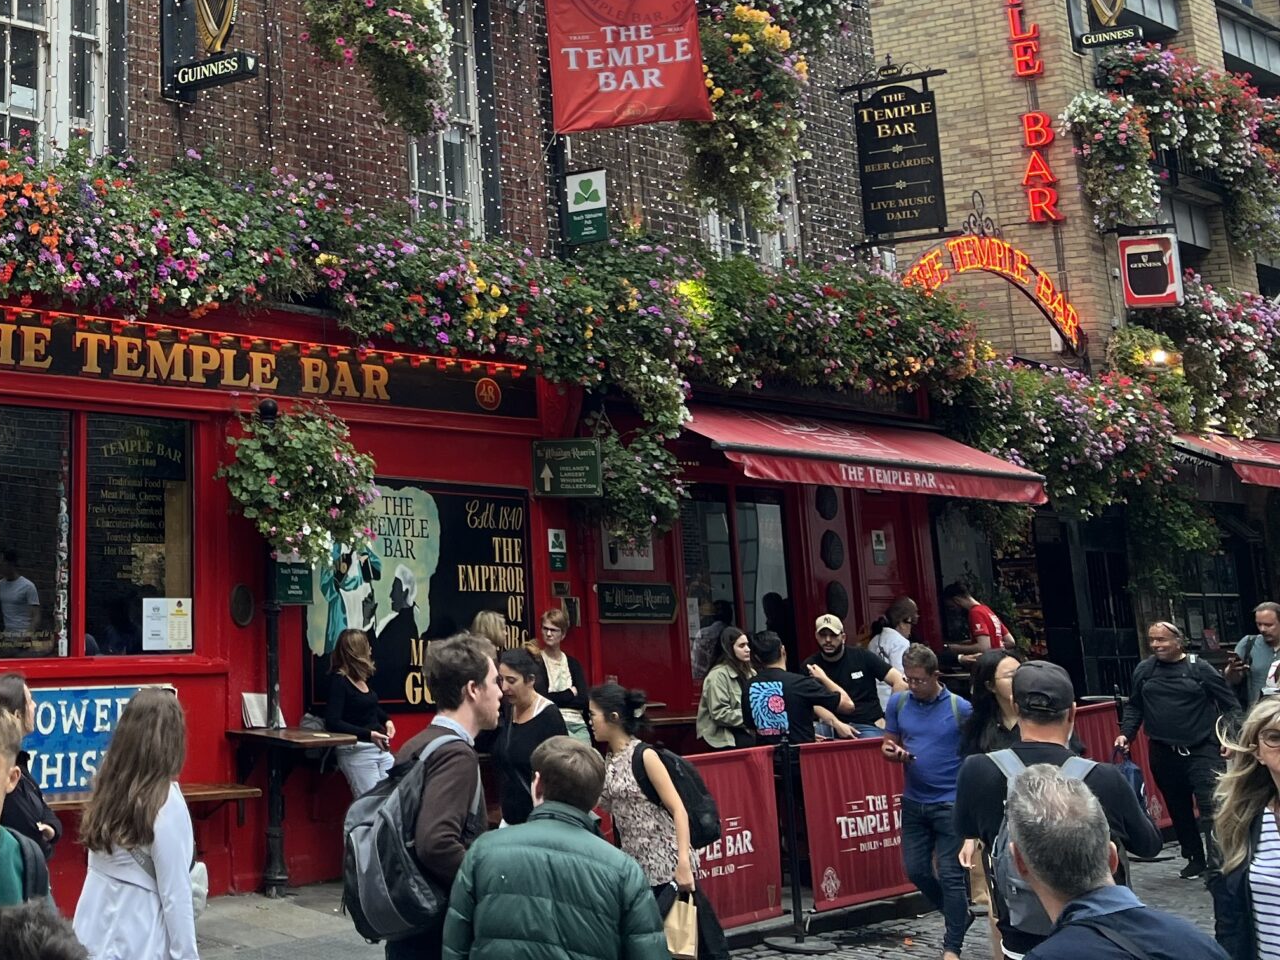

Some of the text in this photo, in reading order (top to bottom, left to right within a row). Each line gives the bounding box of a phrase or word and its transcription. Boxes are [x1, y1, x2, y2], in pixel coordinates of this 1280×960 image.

[600, 24, 654, 43] THE
[1082, 27, 1135, 46] GUINNESS
[561, 38, 692, 70] TEMPLE
[177, 56, 238, 84] GUINNESS
[598, 68, 664, 92] BAR
[881, 92, 907, 104] THE
[858, 102, 933, 124] TEMPLE
[876, 122, 917, 139] BAR
[864, 156, 935, 173] BEER GARDEN
[1020, 110, 1066, 223] BAR
[870, 195, 936, 211] LIVE MUSIC
[886, 209, 921, 221] DAILY
[1130, 261, 1162, 269] GUINNESS
[944, 235, 1031, 285] TEMPLE
[1035, 271, 1079, 346] BAR
[72, 330, 280, 391] TEMPLE
[298, 355, 392, 401] BAR
[479, 383, 496, 404] 48
[101, 439, 182, 464] TEMPLE BAR
[144, 478, 160, 488] Food
[839, 464, 937, 489] THE TEMPLE BAR
[381, 495, 415, 517] THE
[370, 515, 429, 539] TEMPLE
[498, 506, 523, 531] 1840
[383, 537, 416, 560] BAR
[492, 536, 523, 564] THE
[457, 564, 525, 593] EMPEROR
[507, 595, 524, 622] OF
[865, 794, 889, 813] THE
[835, 811, 891, 840] TEMPLE
[725, 830, 754, 857] BAR
[859, 840, 880, 853] DUBLIN
[711, 863, 736, 878] IRELAND
